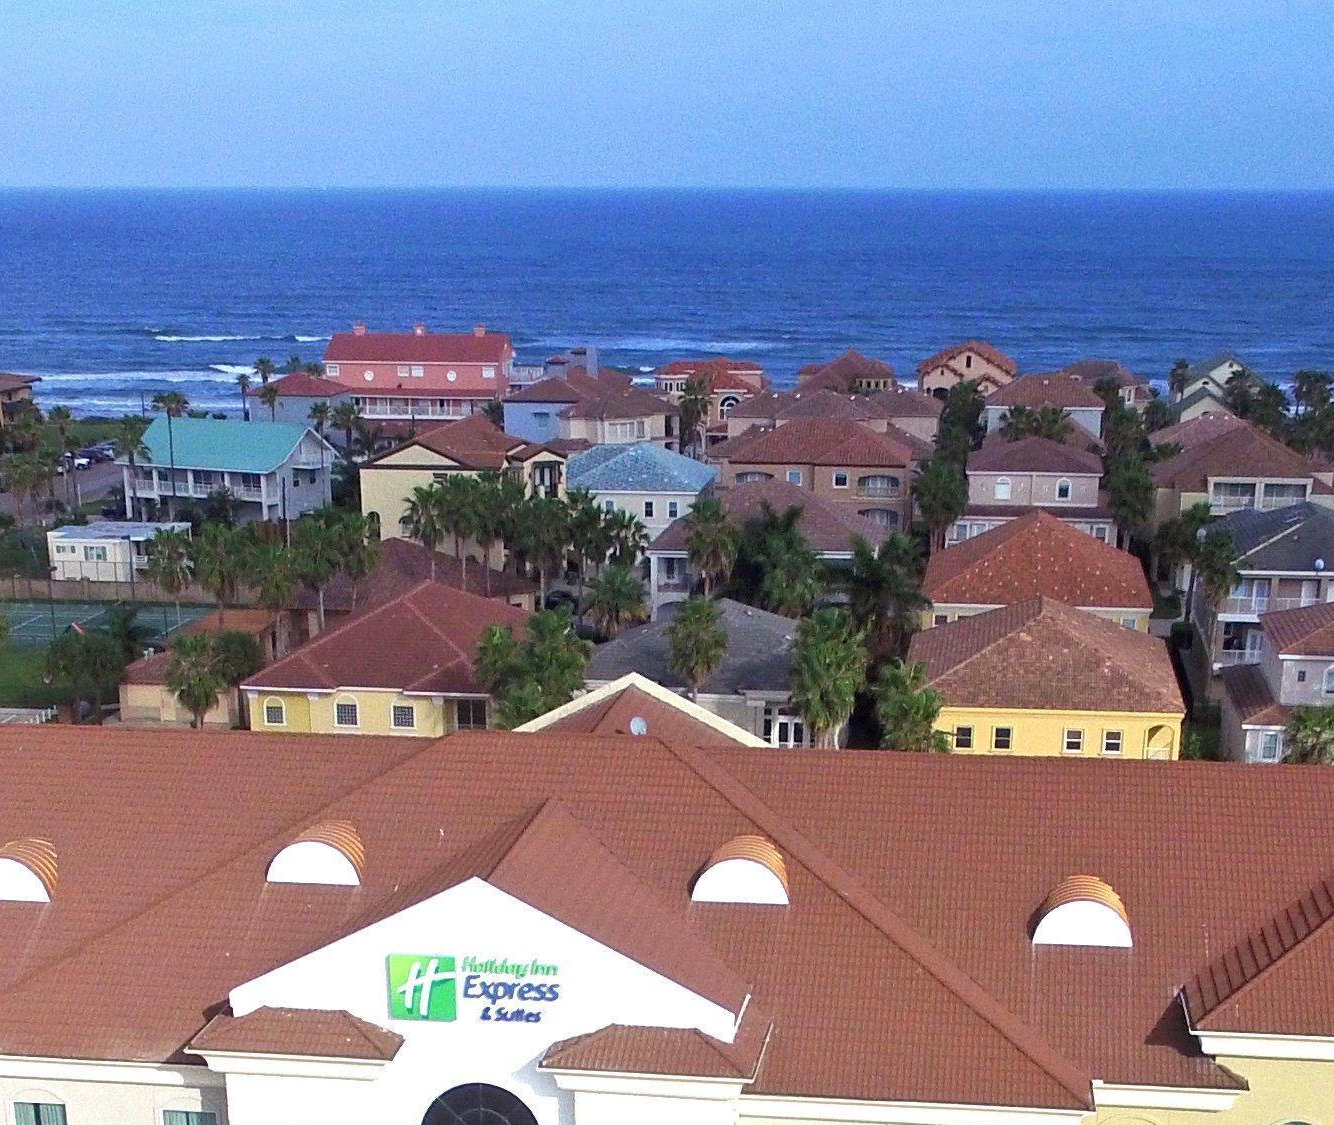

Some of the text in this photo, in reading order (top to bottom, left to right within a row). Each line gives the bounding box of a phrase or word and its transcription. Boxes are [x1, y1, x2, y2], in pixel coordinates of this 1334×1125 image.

[462, 956, 559, 979] Holiday Inn
[463, 974, 560, 1005] Express
[480, 1006, 542, 1023] & Suites
